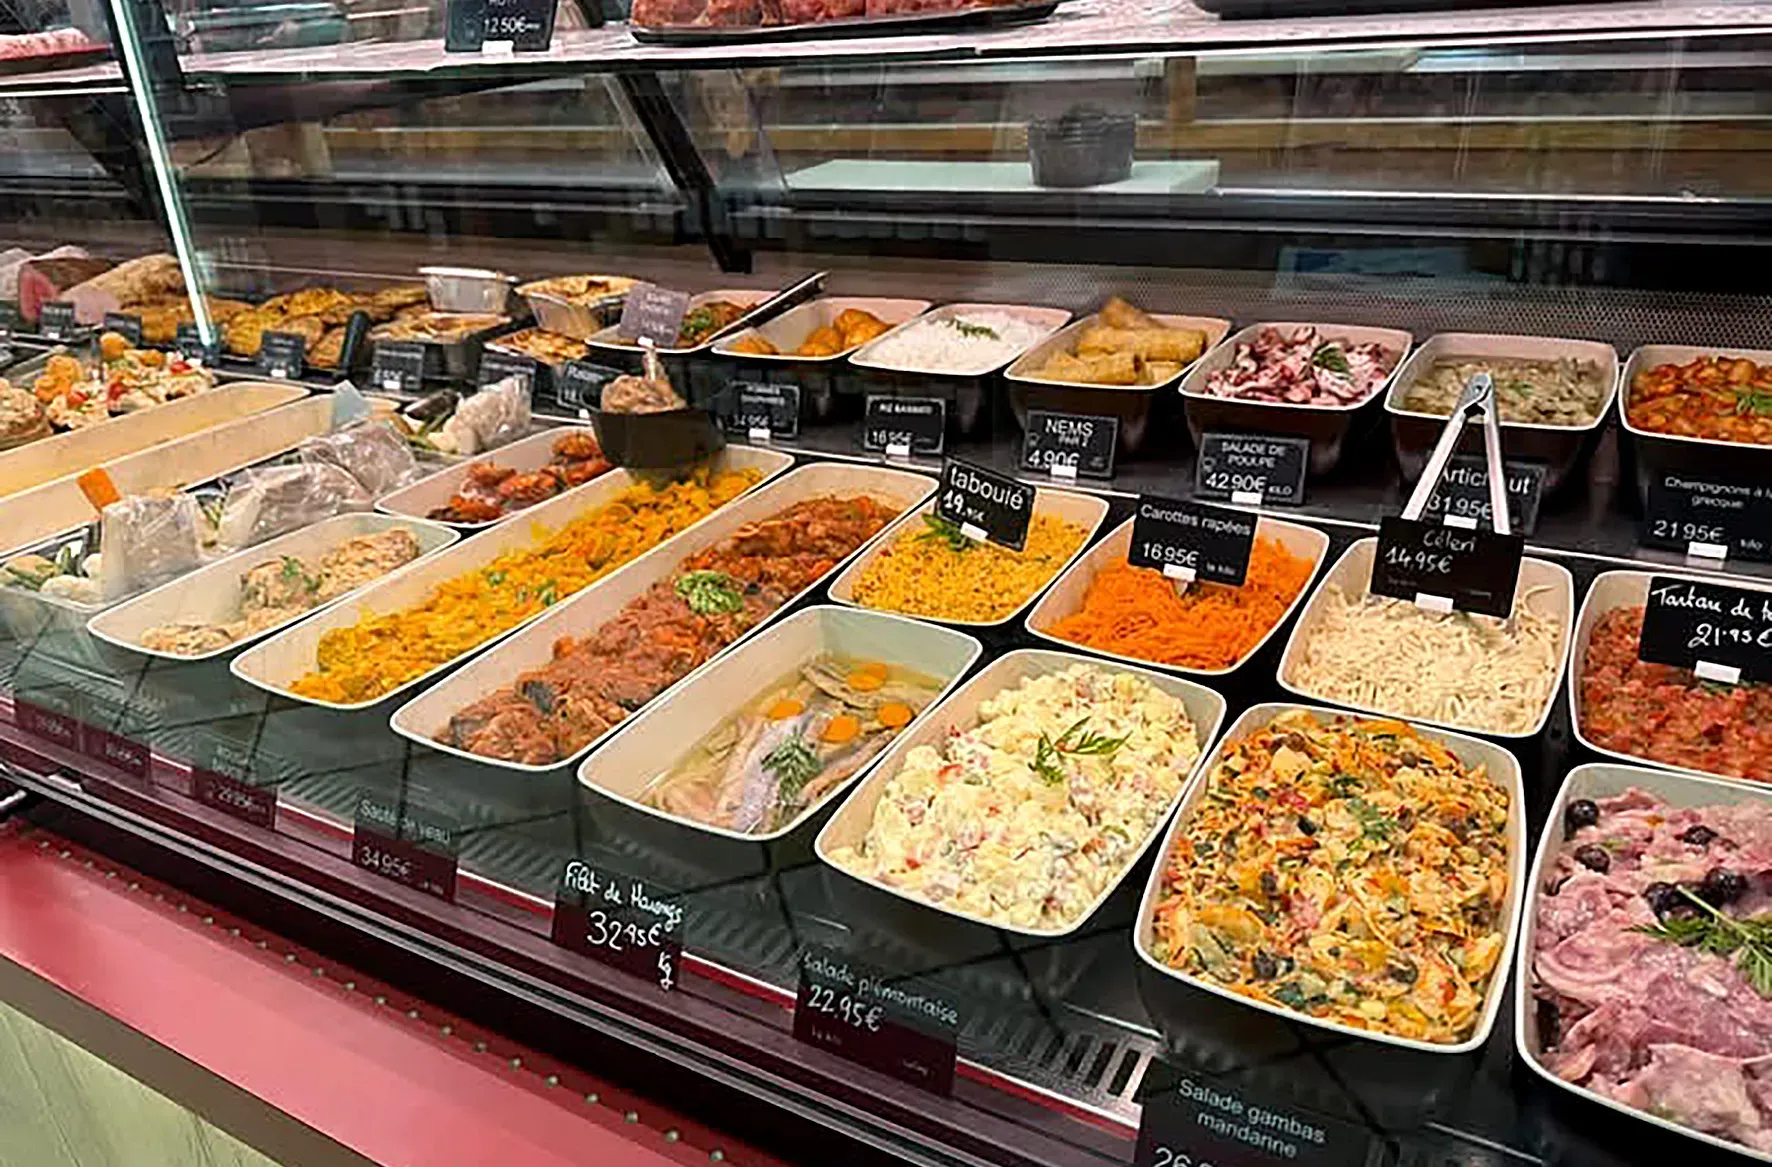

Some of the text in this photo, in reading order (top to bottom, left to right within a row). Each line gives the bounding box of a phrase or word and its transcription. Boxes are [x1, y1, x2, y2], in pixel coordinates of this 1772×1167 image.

[1045, 418, 1094, 437] NEMS
[1221, 441, 1286, 457] SALADE DE
[1140, 503, 1198, 527] Carottes
[1422, 529, 1479, 553] Céleri
[1730, 597, 1755, 620] de
[565, 861, 601, 896] Filet
[603, 880, 623, 905] de
[803, 951, 855, 986] Salade
[1178, 1078, 1326, 1145] Salade gambas
